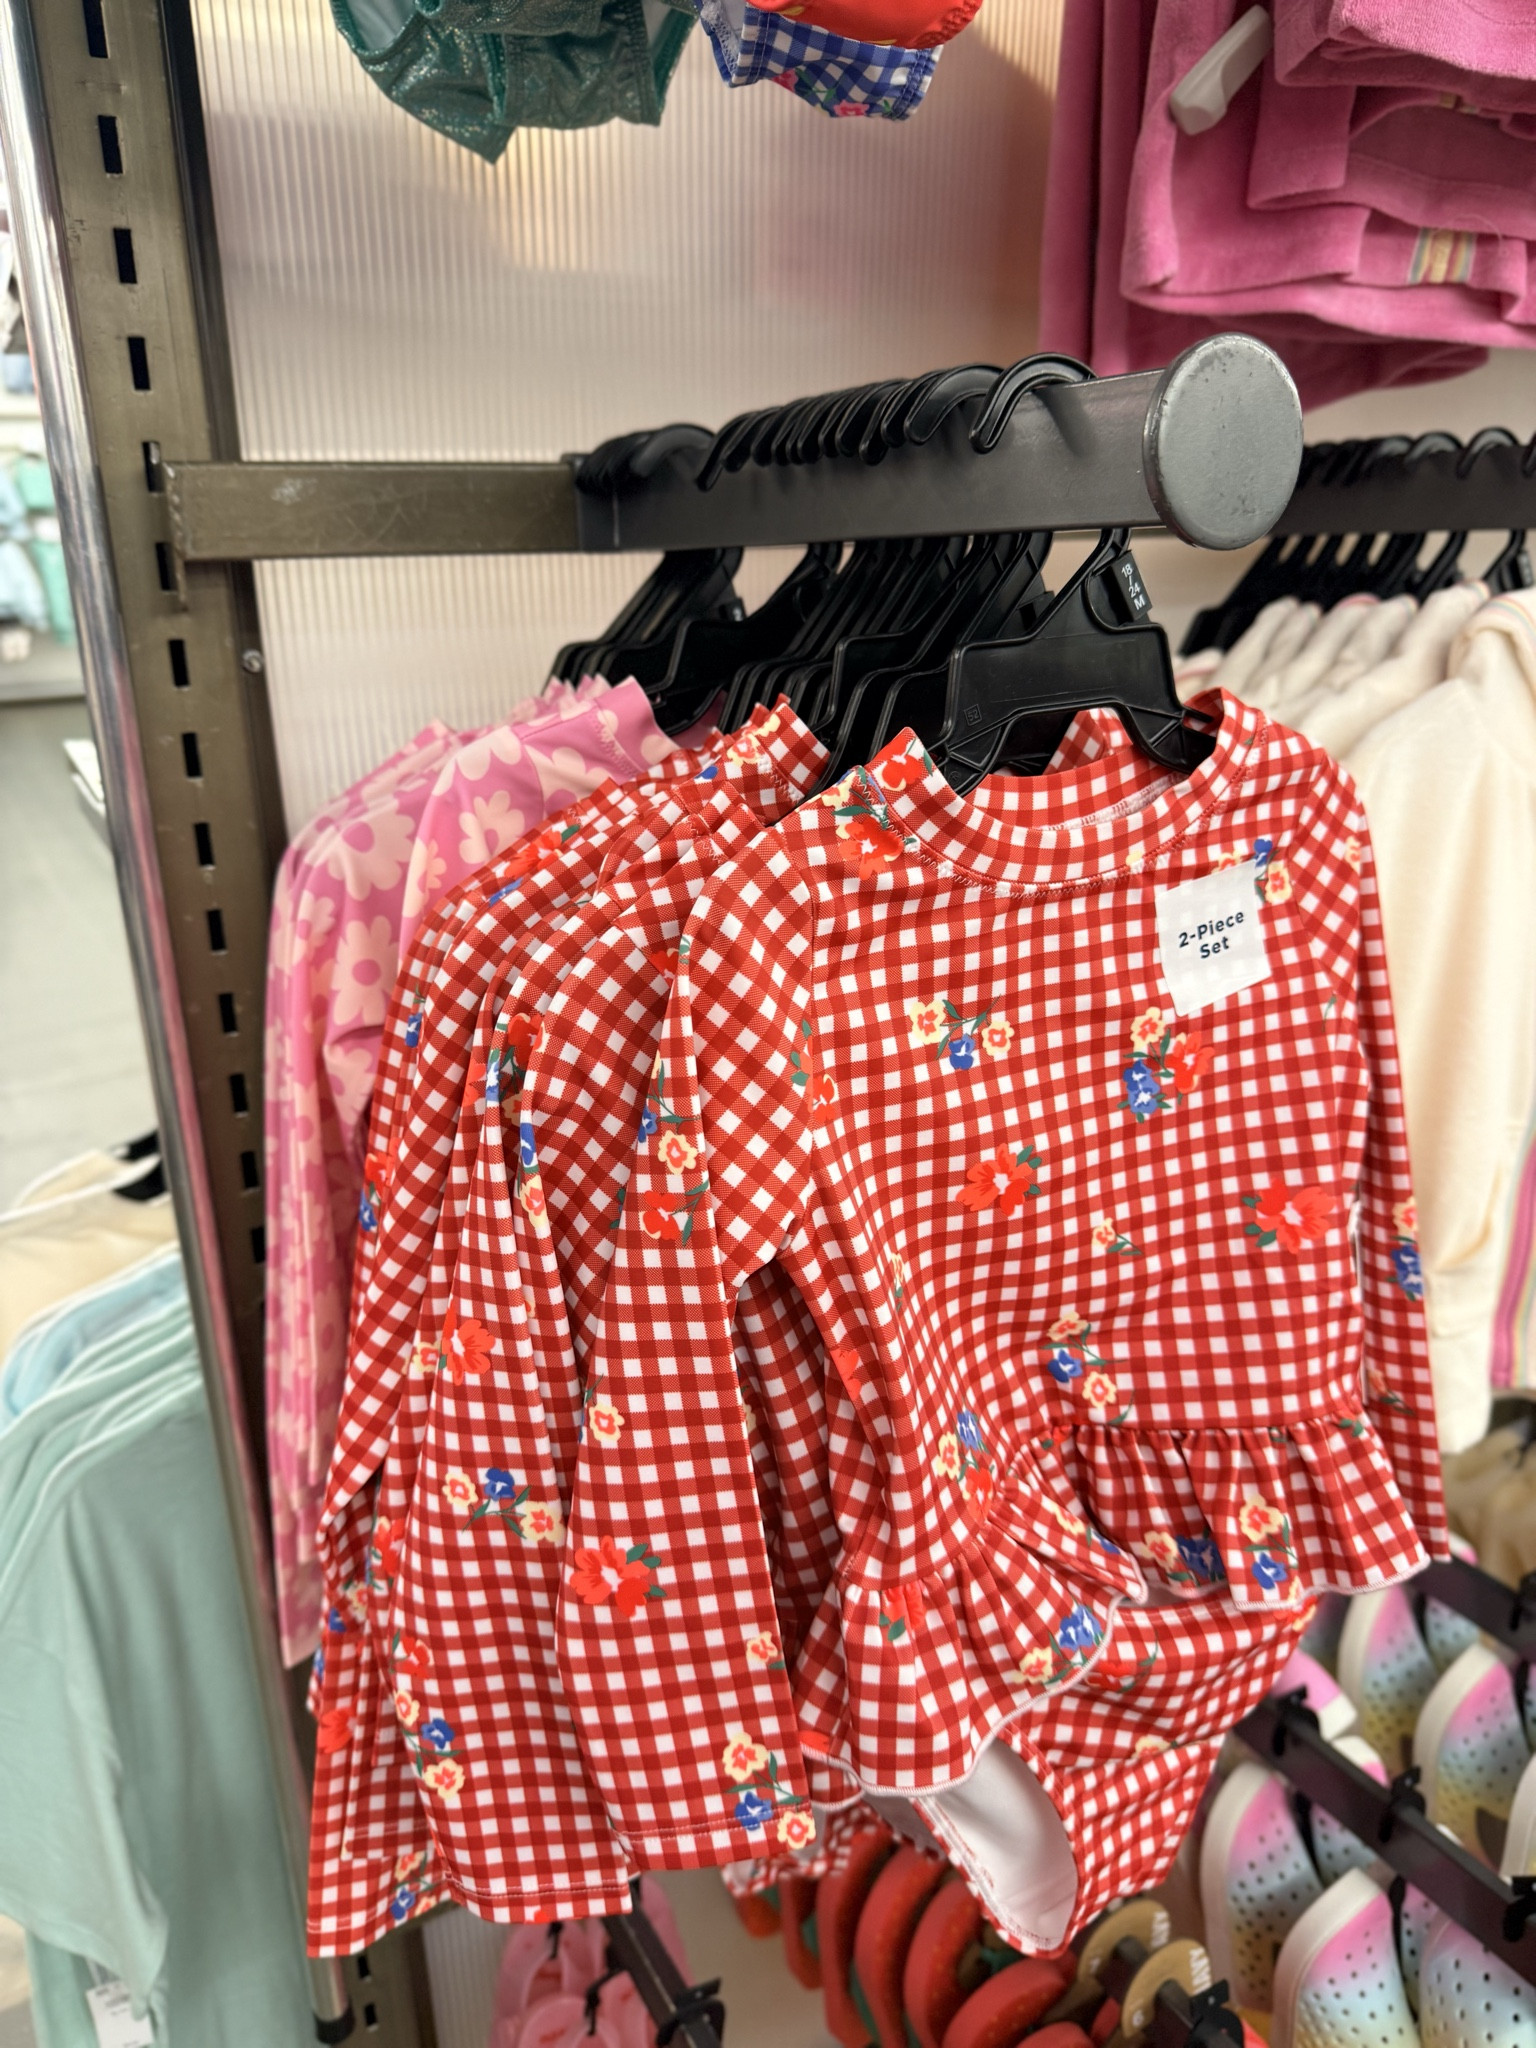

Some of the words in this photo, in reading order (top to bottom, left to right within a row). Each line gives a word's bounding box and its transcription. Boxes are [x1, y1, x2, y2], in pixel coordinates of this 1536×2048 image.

[1121, 563, 1133, 578] 18
[1128, 582, 1141, 598] 24
[1133, 594, 1146, 610] M
[1178, 911, 1245, 948] 2-Piece
[1199, 936, 1230, 959] Set
